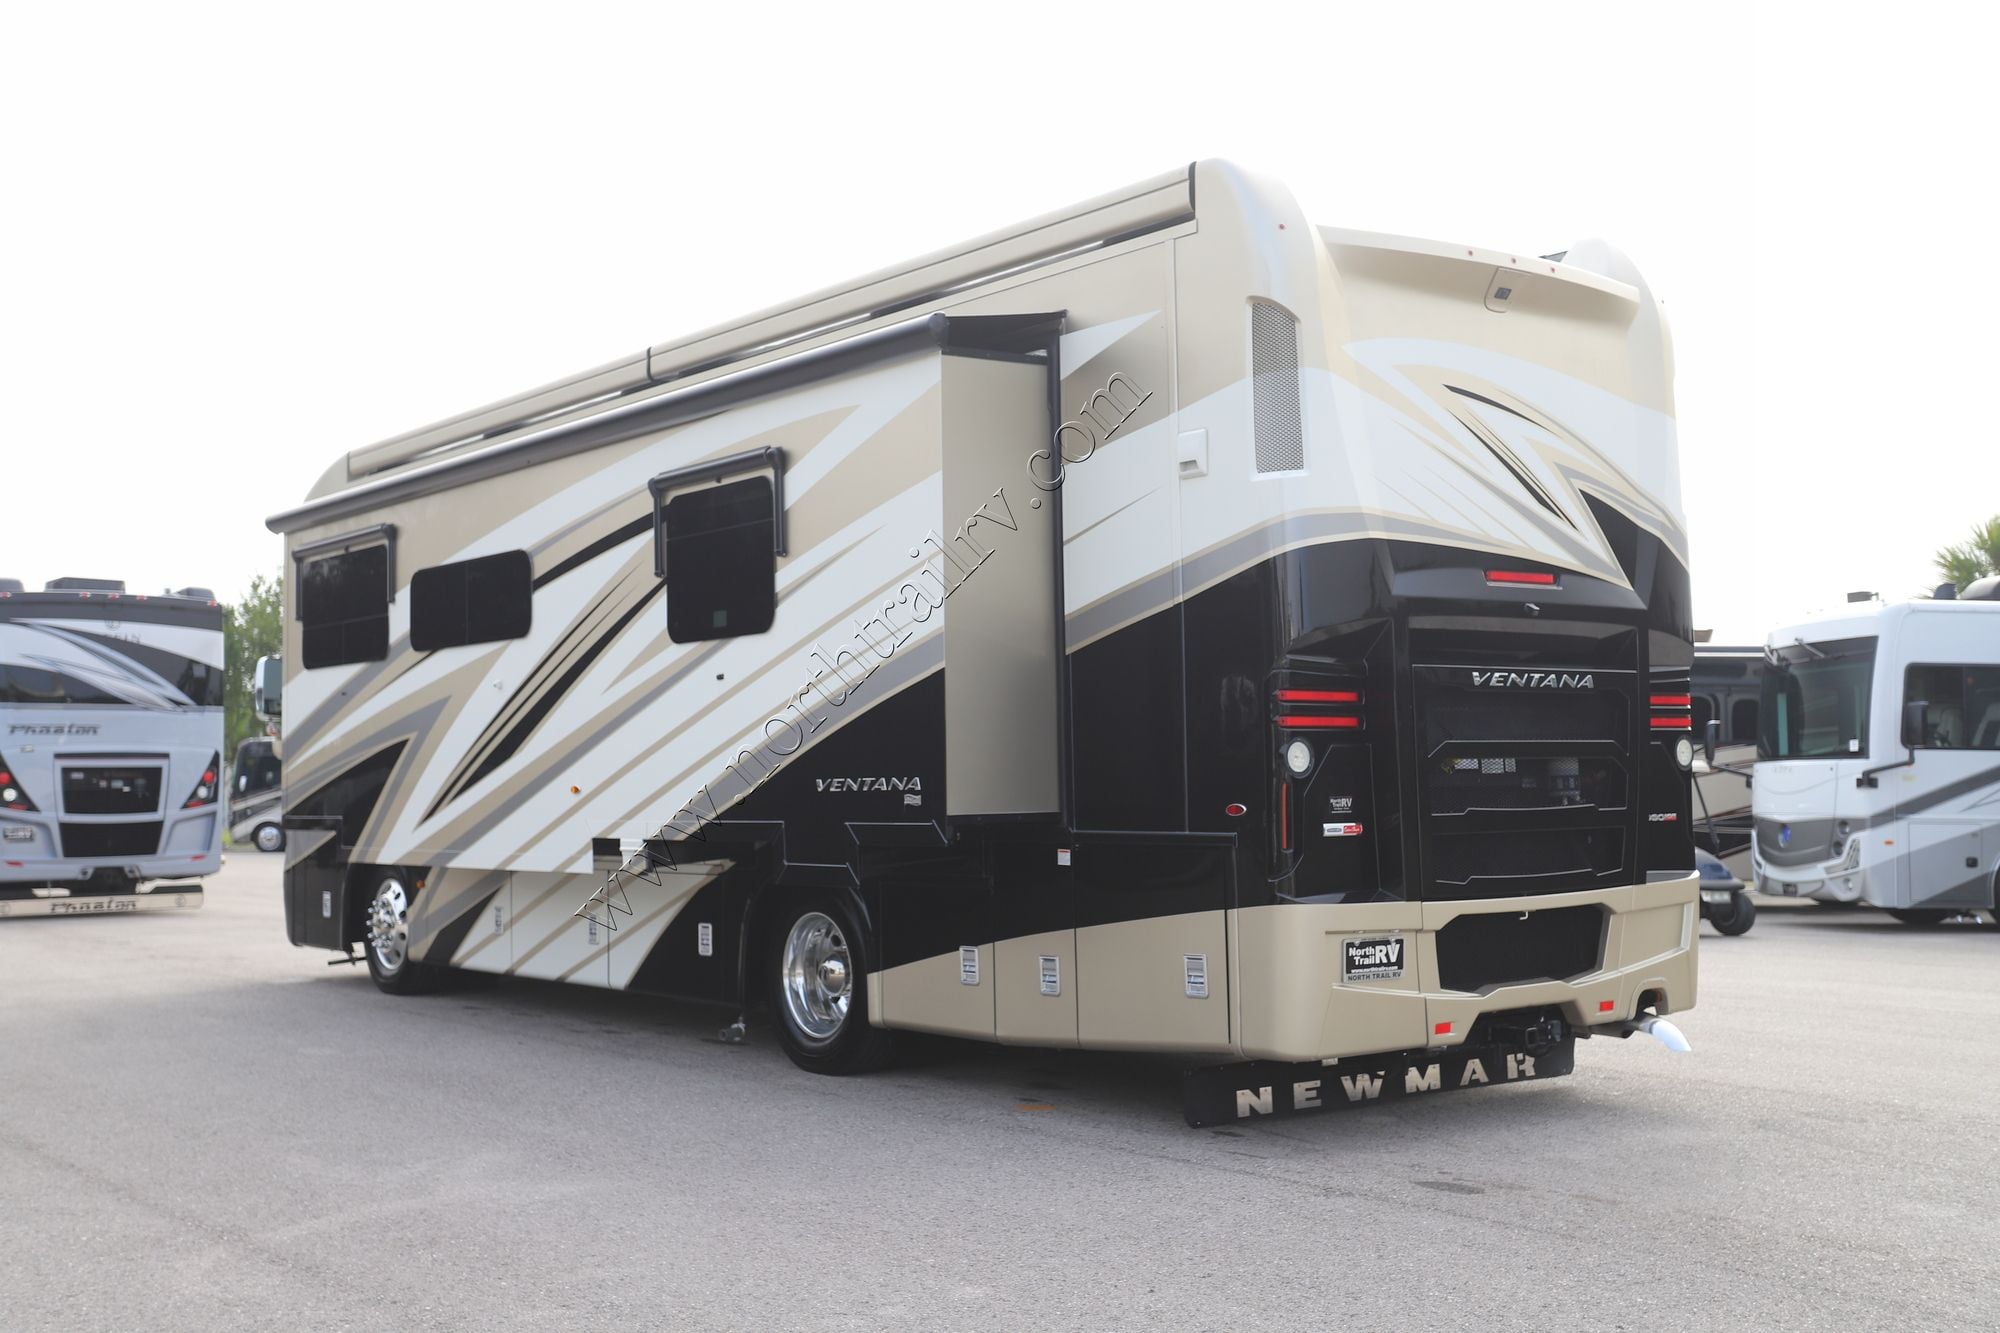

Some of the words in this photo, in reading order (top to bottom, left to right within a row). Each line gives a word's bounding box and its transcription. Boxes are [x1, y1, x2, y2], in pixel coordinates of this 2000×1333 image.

[1472, 671, 1594, 689] VENTANA
[815, 777, 921, 792] VENTANA
[1348, 946, 1375, 956] North
[1375, 944, 1400, 963] RV
[1353, 955, 1375, 965] Trail
[1236, 1053, 1537, 1118] NEWMAR
